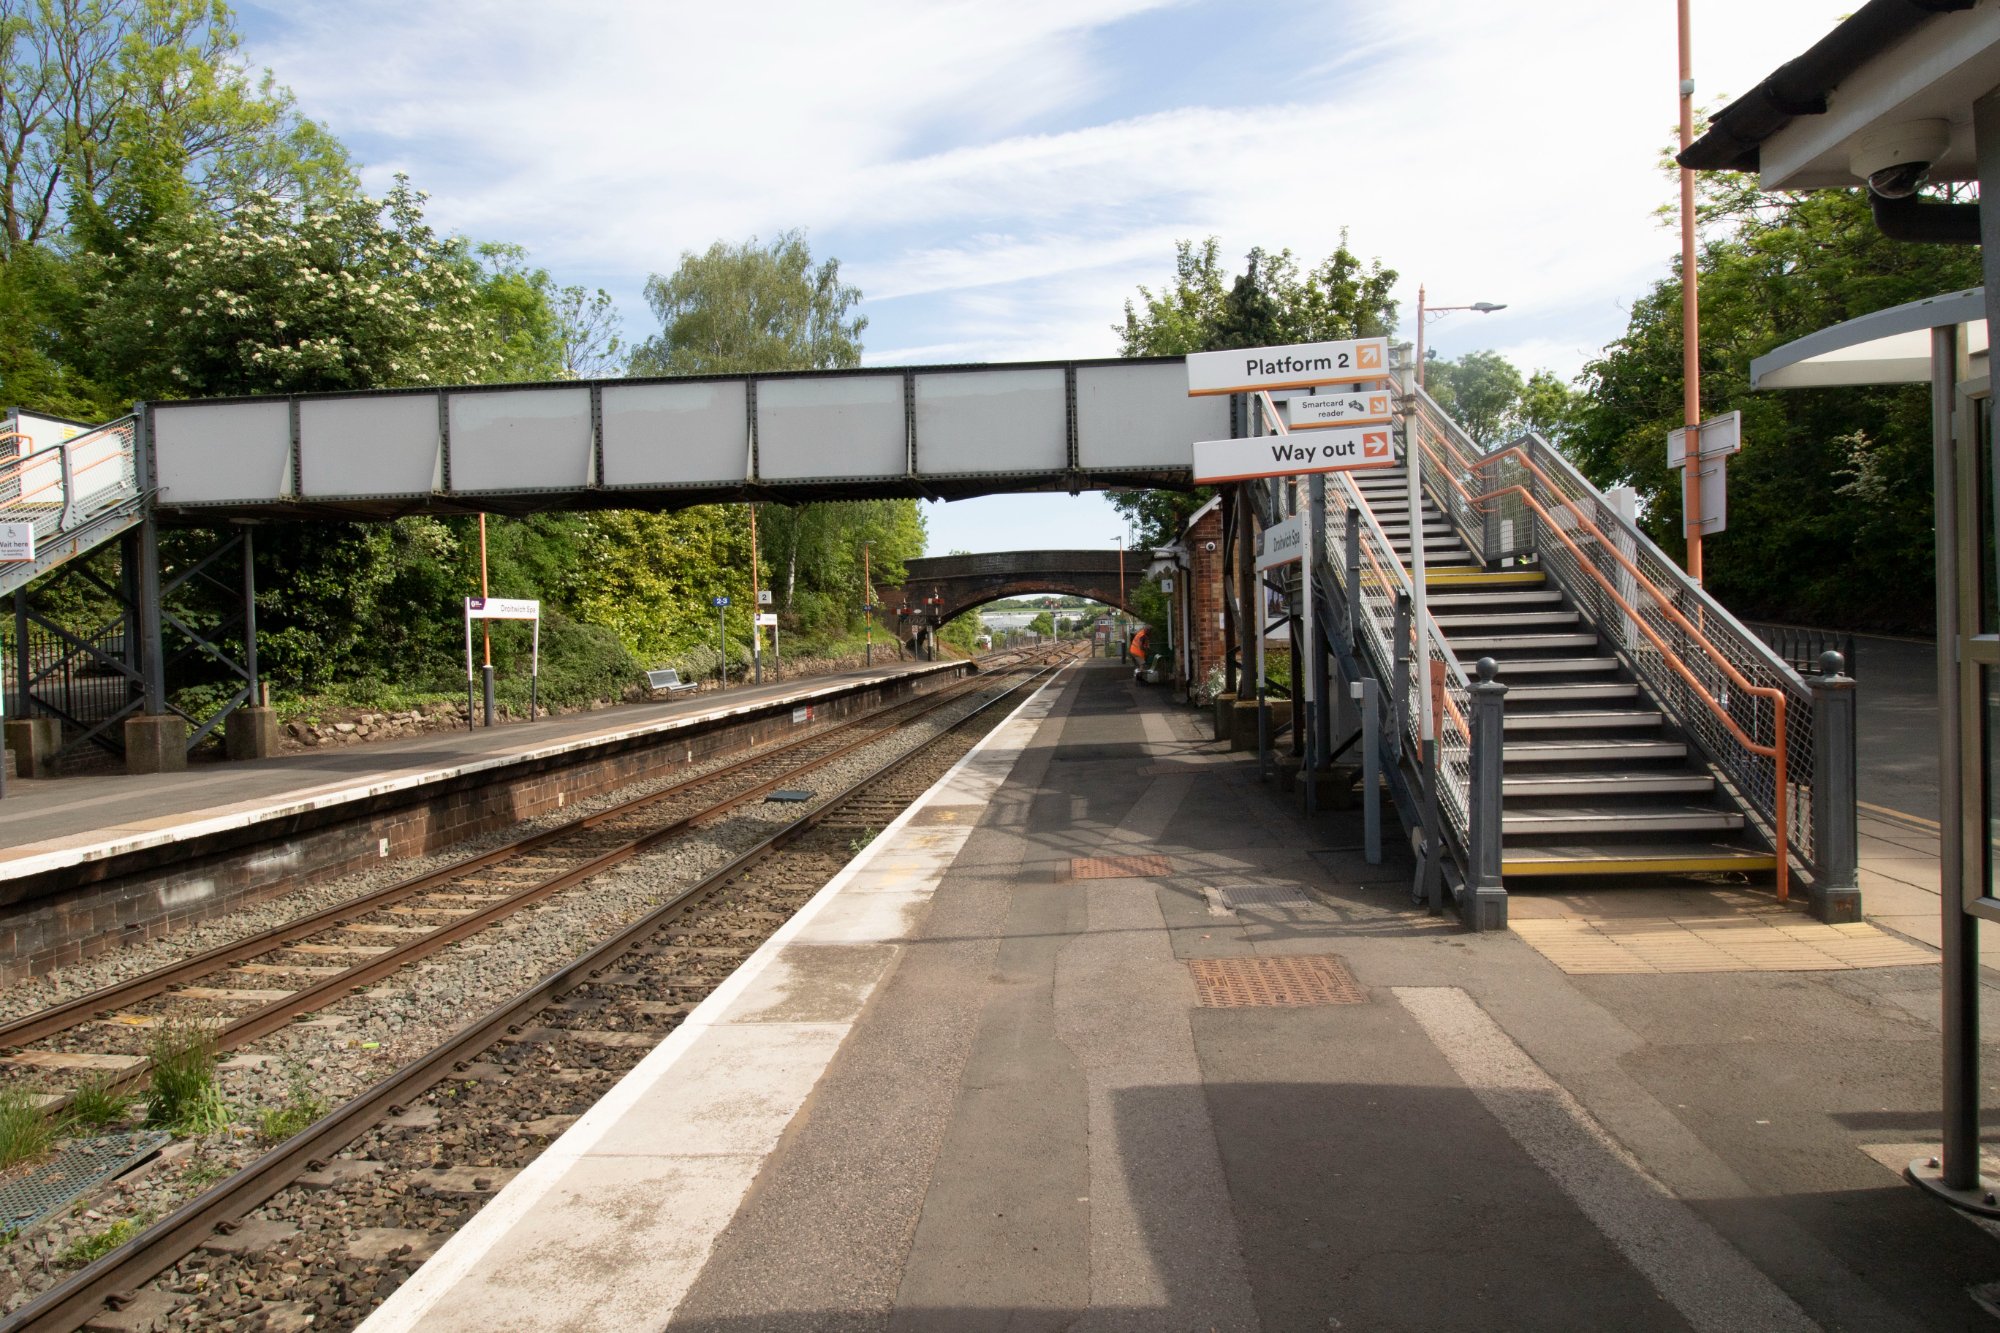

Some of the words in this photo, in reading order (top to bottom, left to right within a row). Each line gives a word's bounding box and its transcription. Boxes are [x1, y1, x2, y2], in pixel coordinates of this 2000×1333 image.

[1247, 356, 1332, 376] Platform
[1338, 353, 1350, 368] 2
[1302, 399, 1344, 409] Smartcard
[1318, 410, 1344, 418] reader
[1272, 444, 1316, 463] Way
[1322, 440, 1356, 458] out
